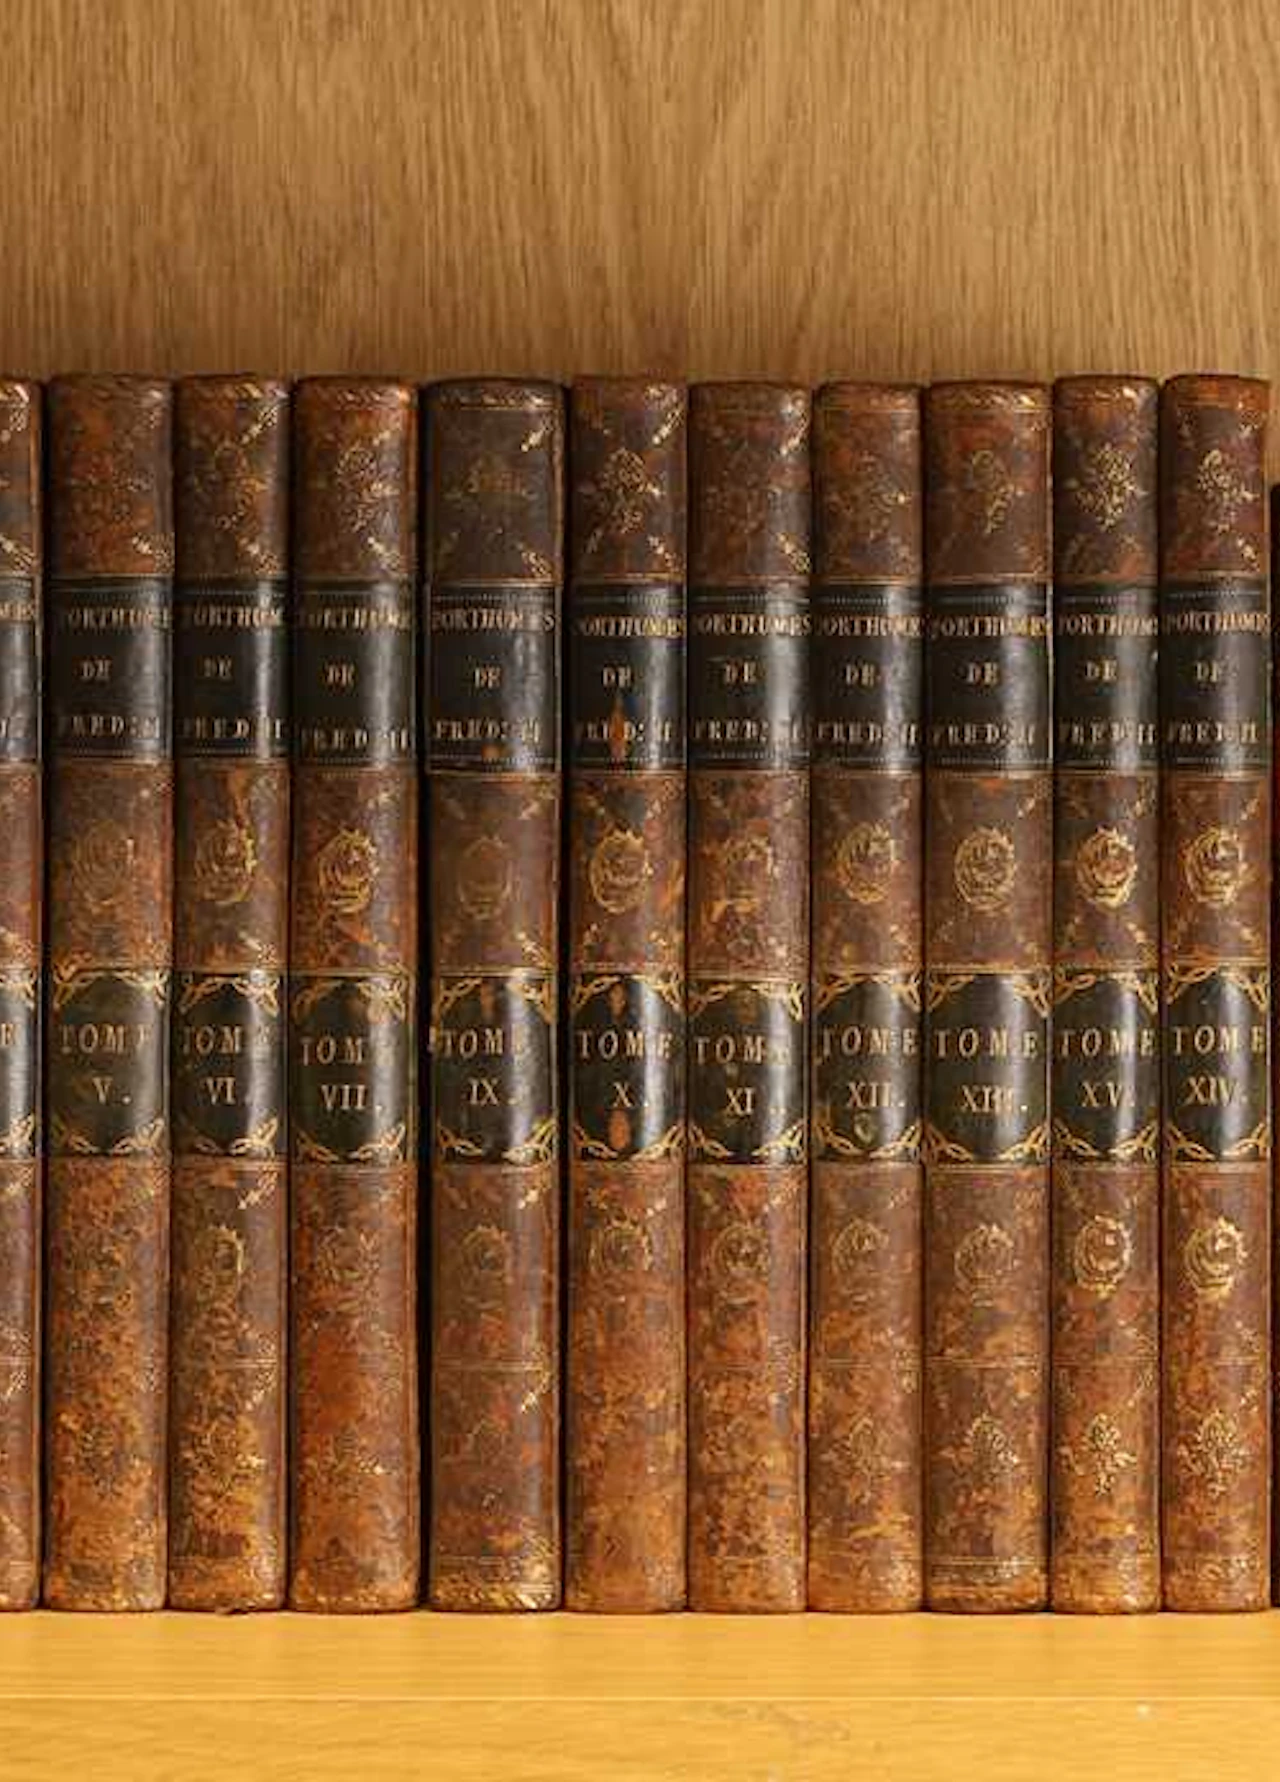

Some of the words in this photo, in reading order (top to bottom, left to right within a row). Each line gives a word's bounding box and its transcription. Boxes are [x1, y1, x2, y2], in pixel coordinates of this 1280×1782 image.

[724, 660, 759, 685] DE
[844, 662, 876, 687] DE
[964, 661, 1000, 686] DE
[1084, 660, 1117, 685] DE
[300, 1036, 378, 1067] TOM
[576, 1029, 672, 1062] TOME
[823, 1026, 919, 1060] TOME
[935, 1027, 1039, 1060] TOME
[1060, 1027, 1154, 1058] TOME
[1174, 1024, 1266, 1056] TOME
[92, 1076, 132, 1105] V.
